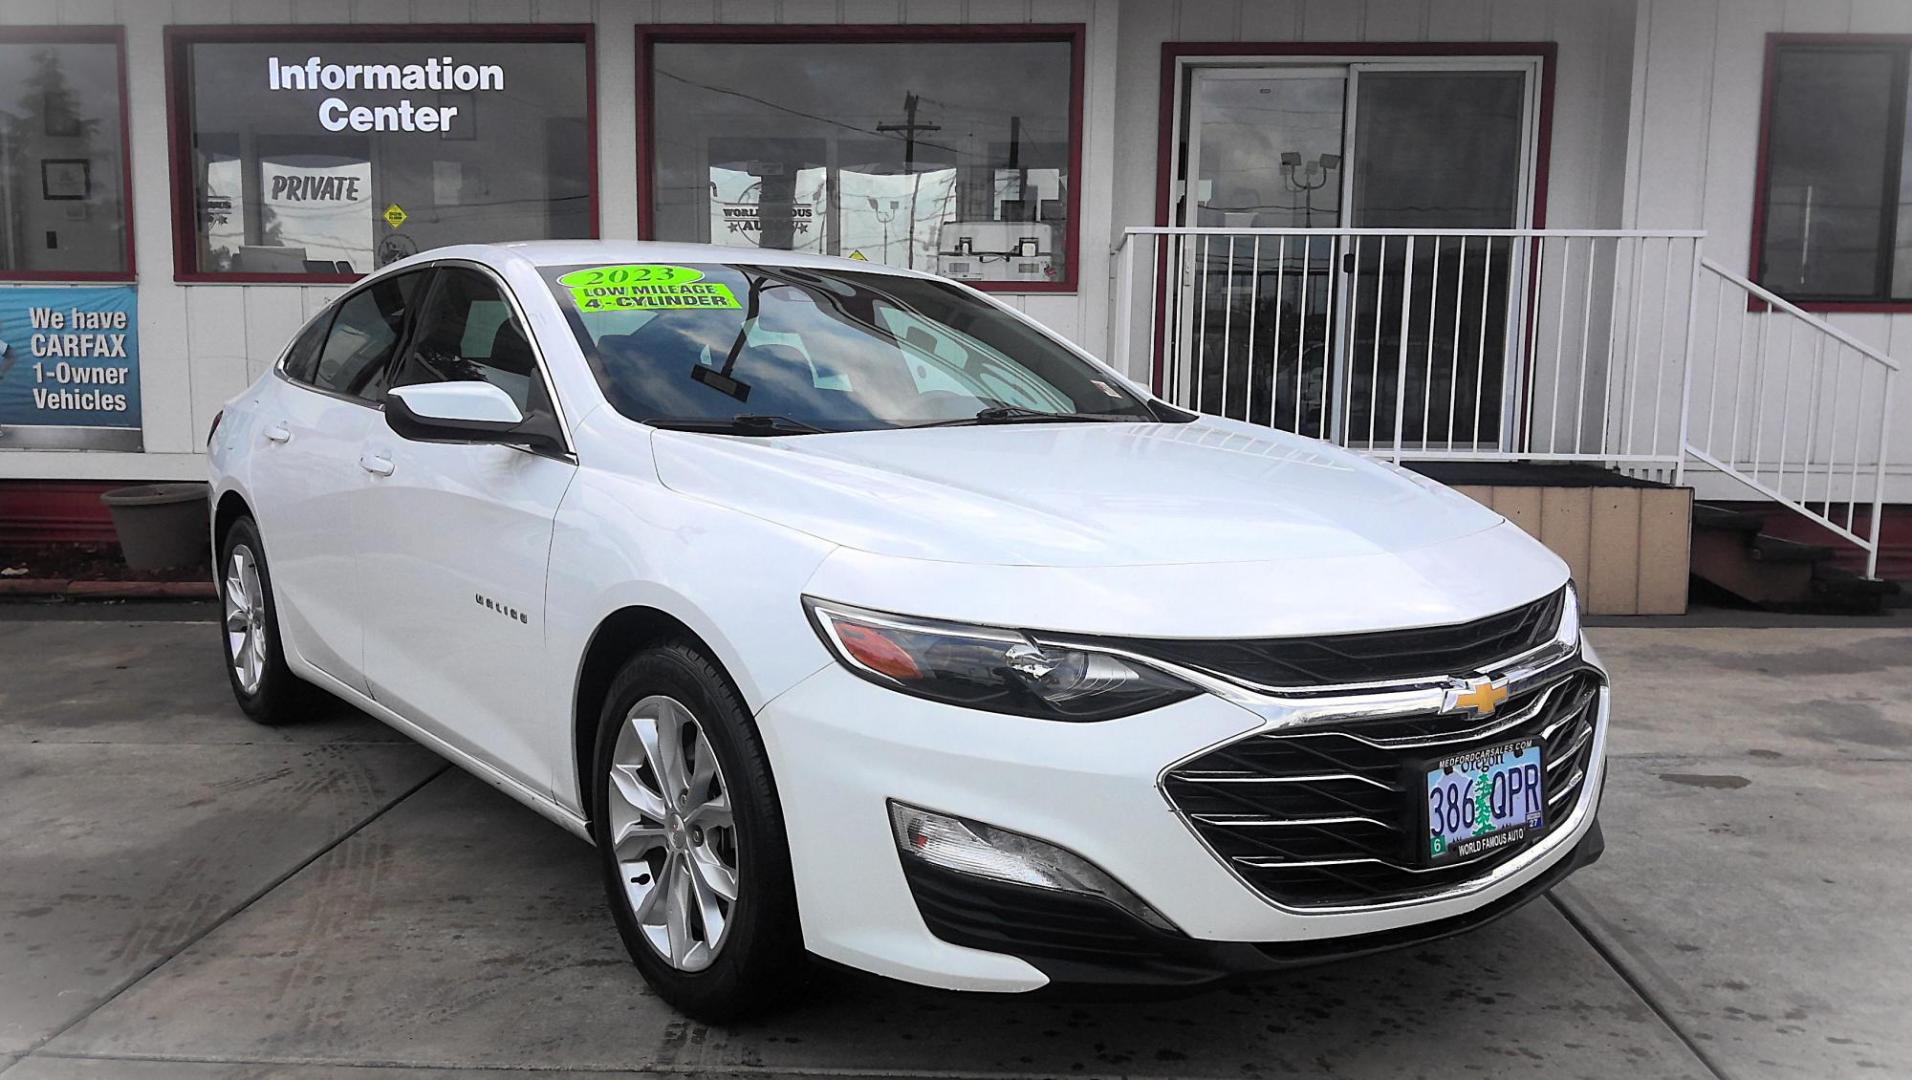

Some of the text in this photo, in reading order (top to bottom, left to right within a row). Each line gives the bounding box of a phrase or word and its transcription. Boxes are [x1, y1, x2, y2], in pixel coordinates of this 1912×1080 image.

[269, 57, 504, 90] Information
[318, 98, 458, 132] Center
[271, 175, 361, 201] PRIVATE
[586, 267, 675, 285] 2023
[584, 284, 717, 297] LOW MILEAGE
[29, 307, 127, 330] We have
[31, 333, 127, 358] CARFAX
[33, 362, 129, 385] 1-Owner
[33, 388, 127, 411] Vehicles
[1429, 763, 1541, 837] 386 QPR
[1433, 838, 1441, 852] 6
[1458, 827, 1524, 857] WORLD FAMOUS AUTO
